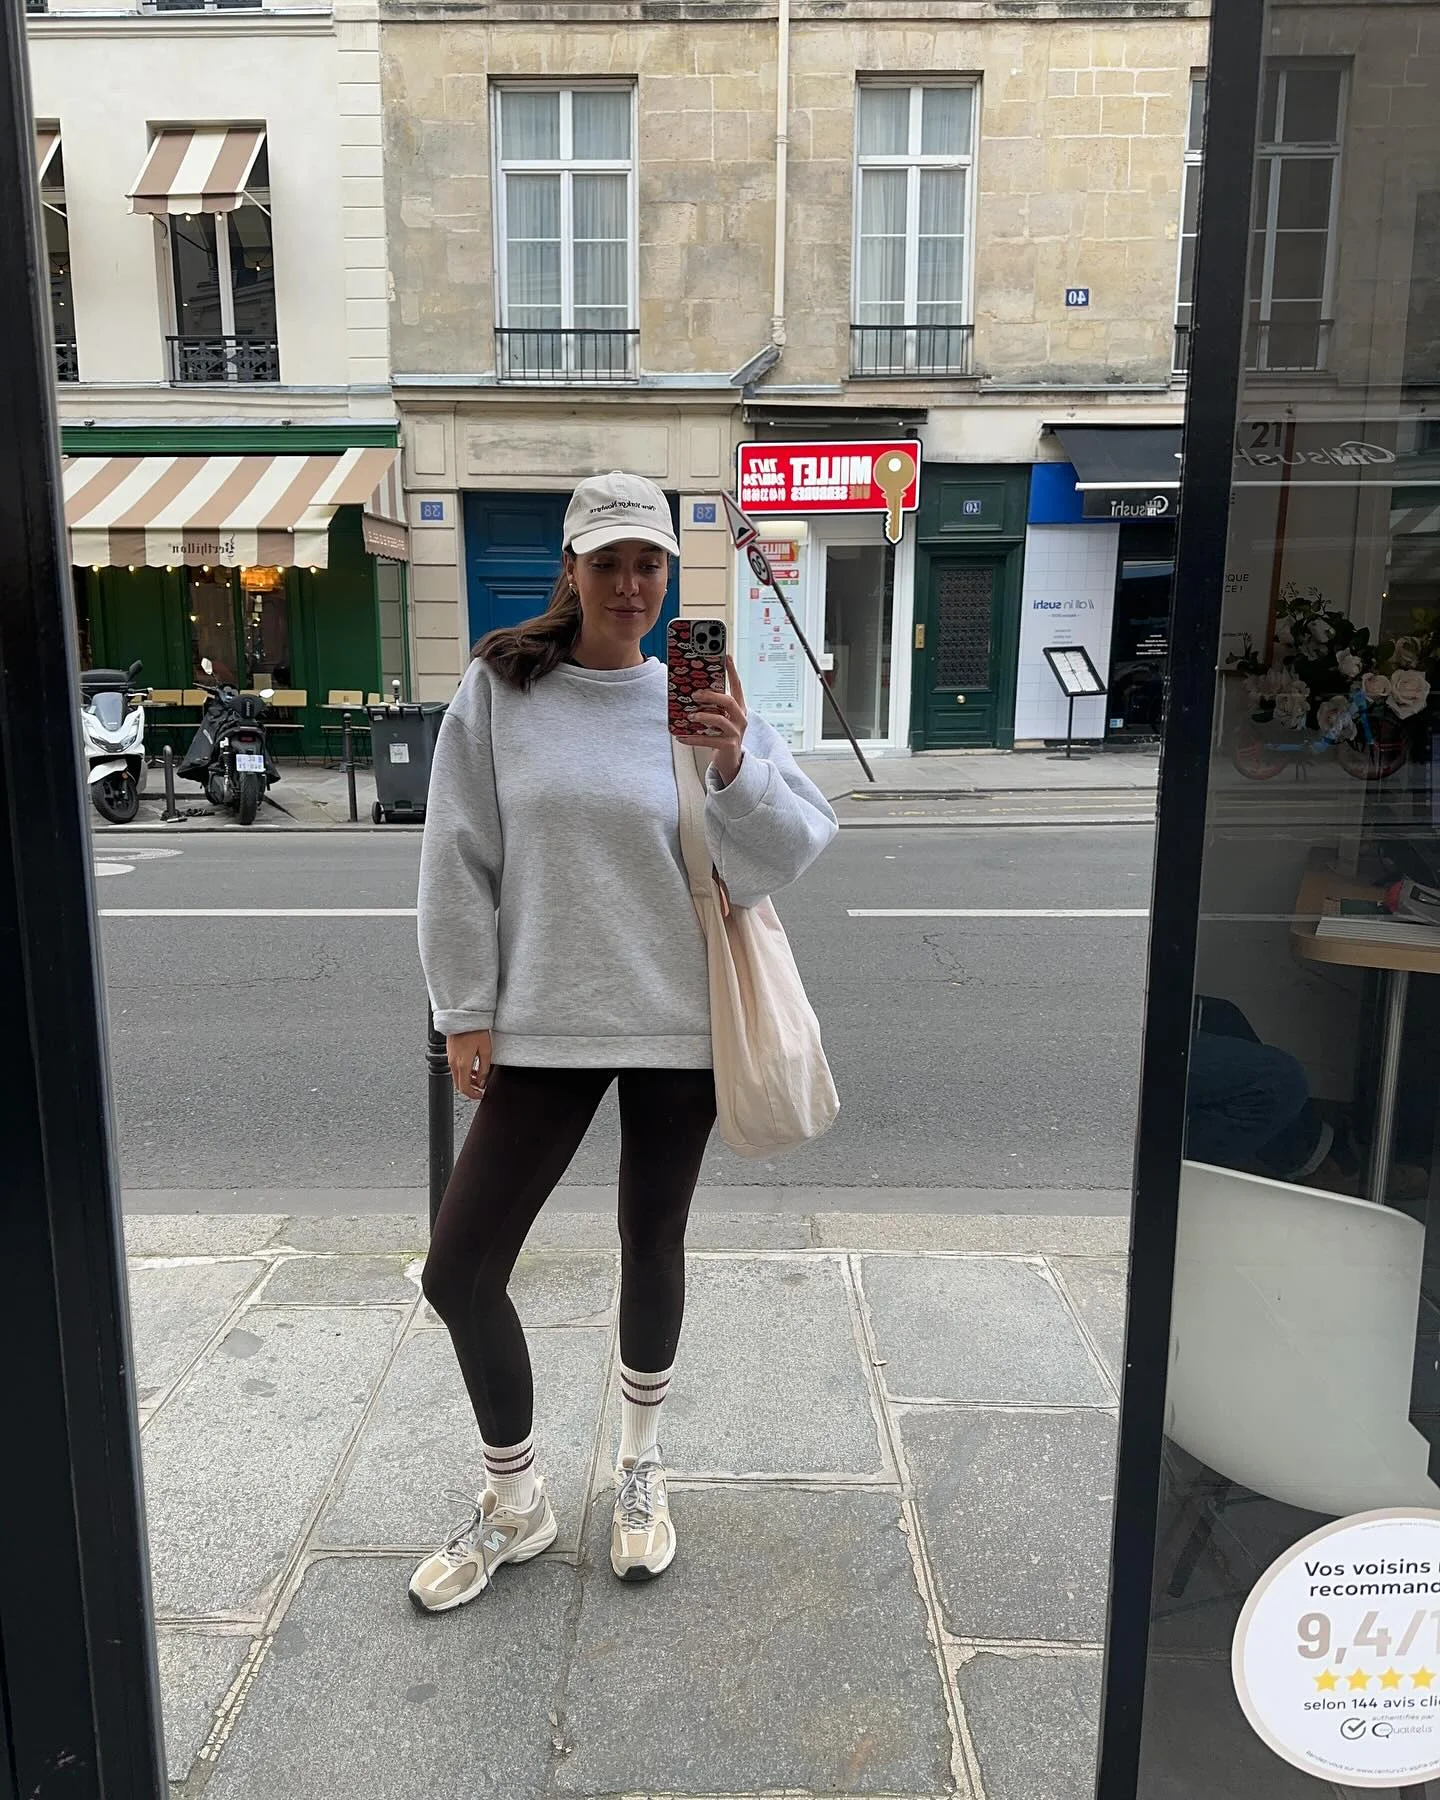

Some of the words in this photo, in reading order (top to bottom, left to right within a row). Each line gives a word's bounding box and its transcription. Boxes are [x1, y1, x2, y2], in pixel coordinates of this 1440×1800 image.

[1251, 422, 1282, 448] 21
[1304, 1561, 1345, 1577] Vos
[1353, 1558, 1431, 1575] voisins
[1304, 1698, 1346, 1710] selon
[1352, 1698, 1378, 1709] 144
[1383, 1696, 1415, 1708] avis
